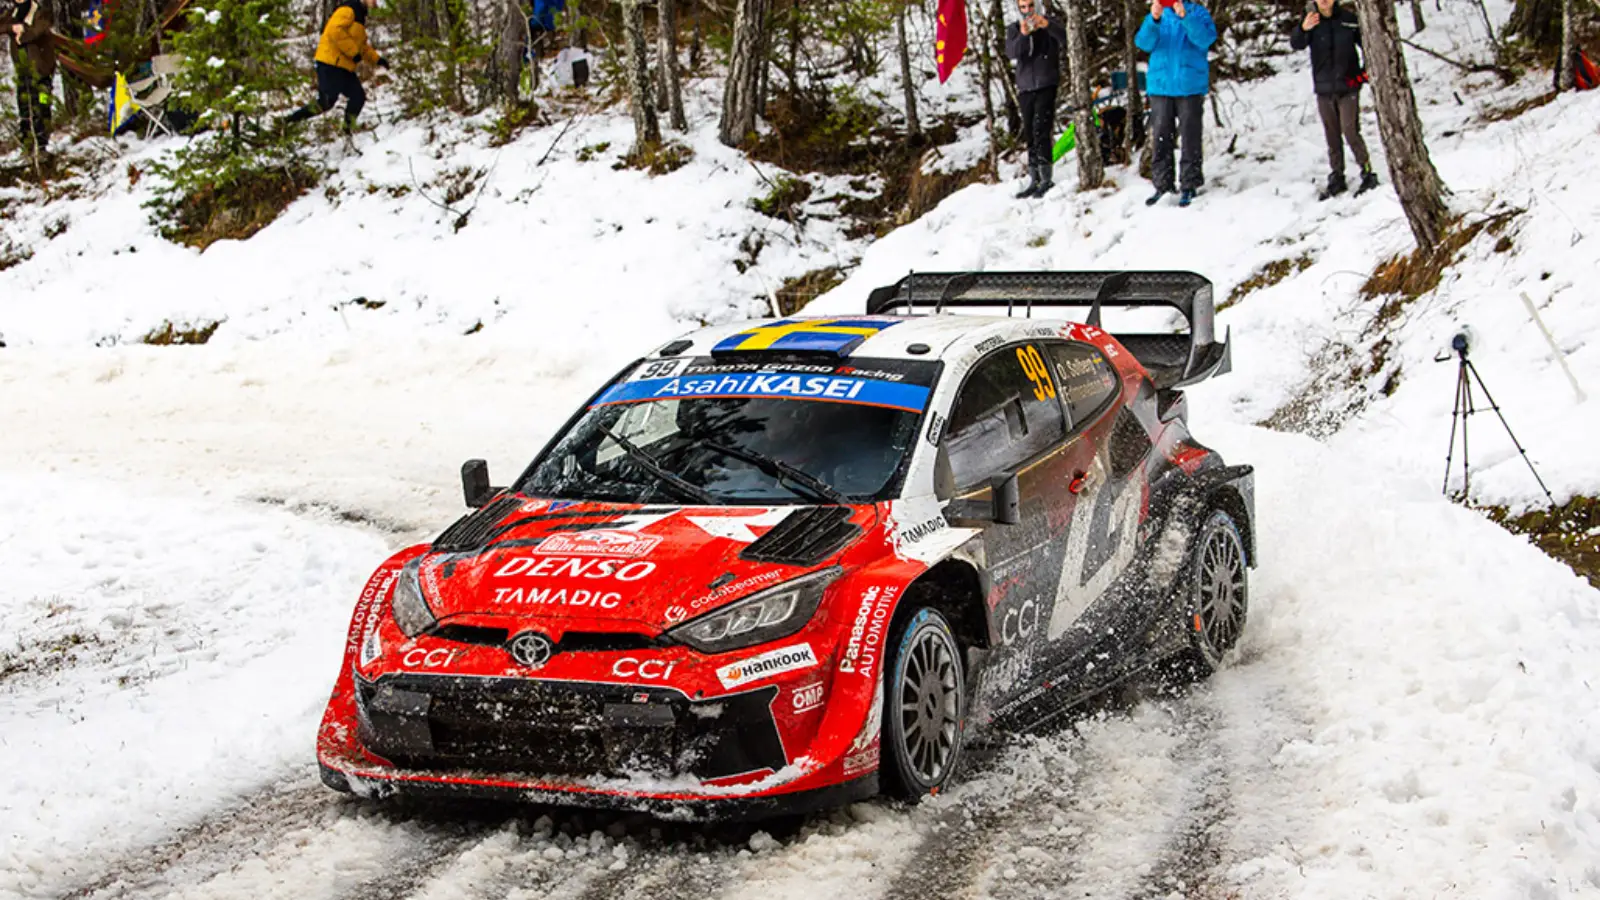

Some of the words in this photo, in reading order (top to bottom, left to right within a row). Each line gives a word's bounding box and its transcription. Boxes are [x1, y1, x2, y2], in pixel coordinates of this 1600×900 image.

[640, 360, 681, 379] 99
[686, 363, 758, 374] TOYOTA
[759, 362, 834, 374] GAZOO
[835, 366, 904, 382] Racing
[1016, 344, 1056, 402] 99
[653, 375, 866, 399] AsahiKASEI
[901, 515, 946, 543] TAMADIC
[493, 557, 656, 581] DENSO
[494, 588, 623, 608] TAMADIC
[839, 585, 880, 673] Panasonic
[859, 585, 899, 678] AUTOMOTIVE
[792, 685, 825, 709] OMP
